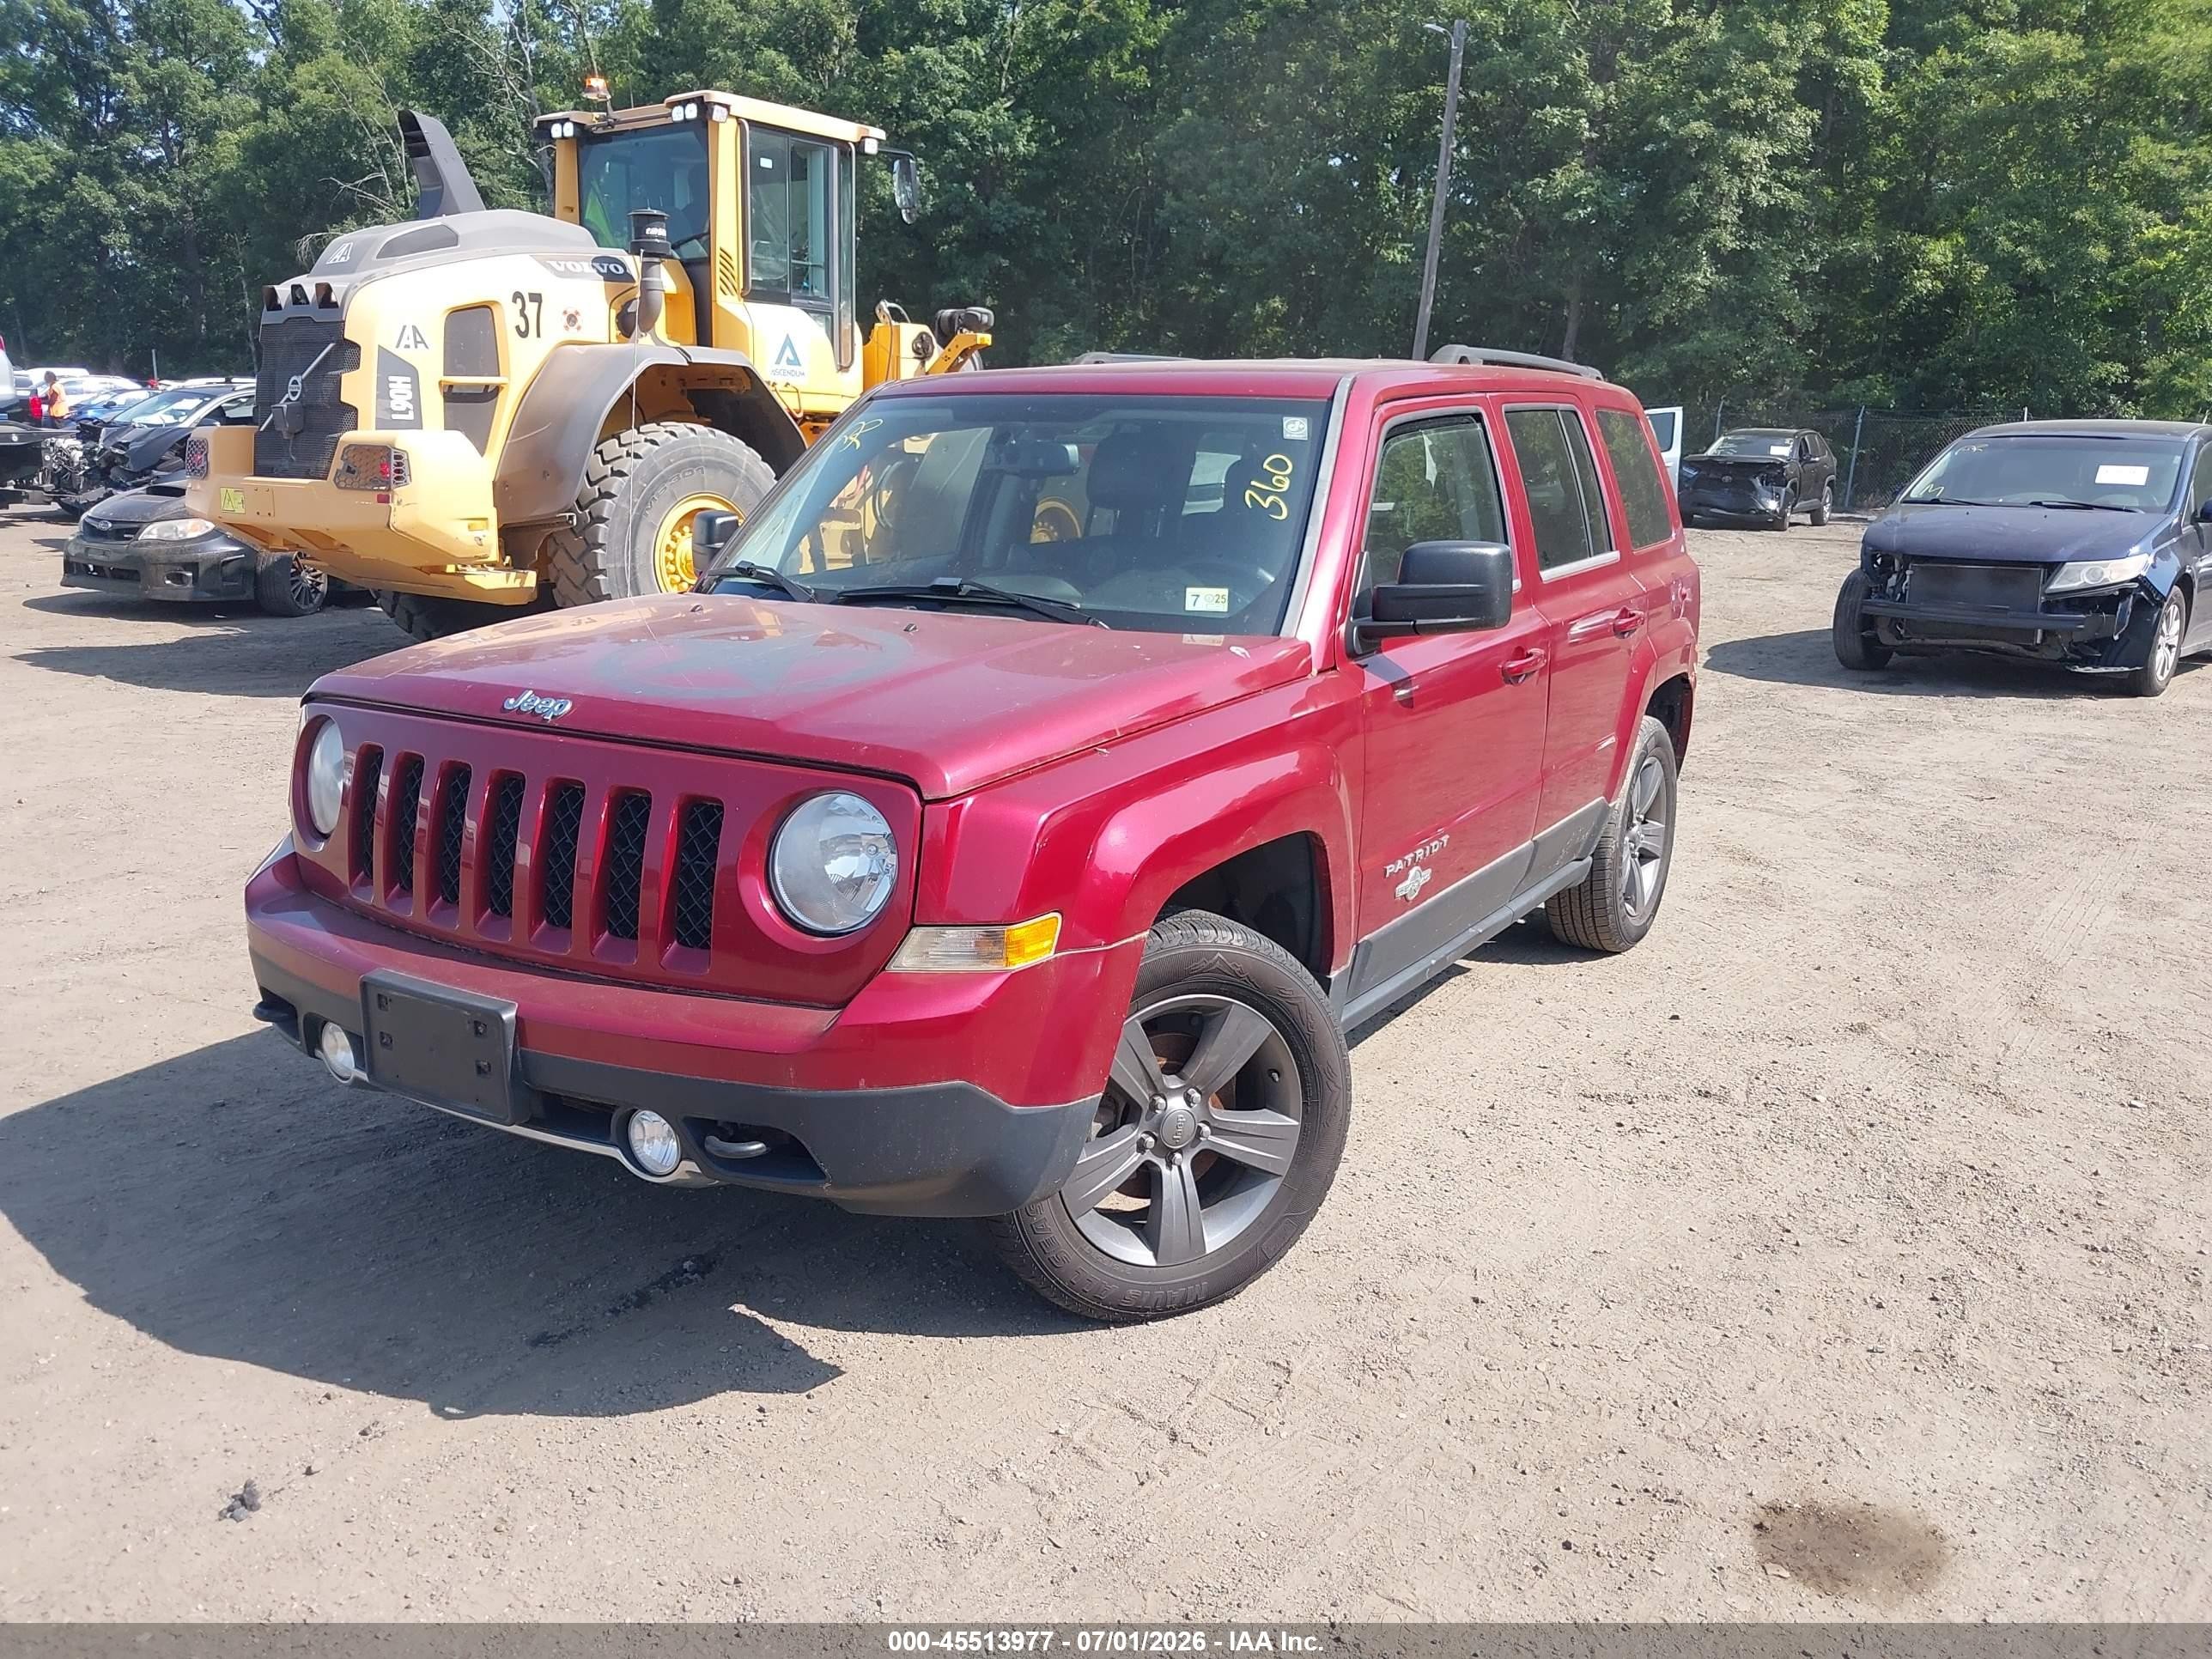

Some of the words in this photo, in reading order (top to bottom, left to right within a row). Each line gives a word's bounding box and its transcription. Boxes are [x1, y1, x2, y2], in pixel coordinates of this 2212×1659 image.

[548, 260, 624, 275] VOLVO
[512, 290, 543, 338] 37
[387, 375, 415, 421] L90H
[1244, 453, 1292, 520] 360
[1190, 594, 1200, 607] 7
[1215, 593, 1226, 604] 25
[503, 689, 573, 720] Jeep
[1383, 834, 1449, 878] PATRIOT
[1173, 1114, 1186, 1143] Jeep
[1069, 1267, 1119, 1300] ALL
